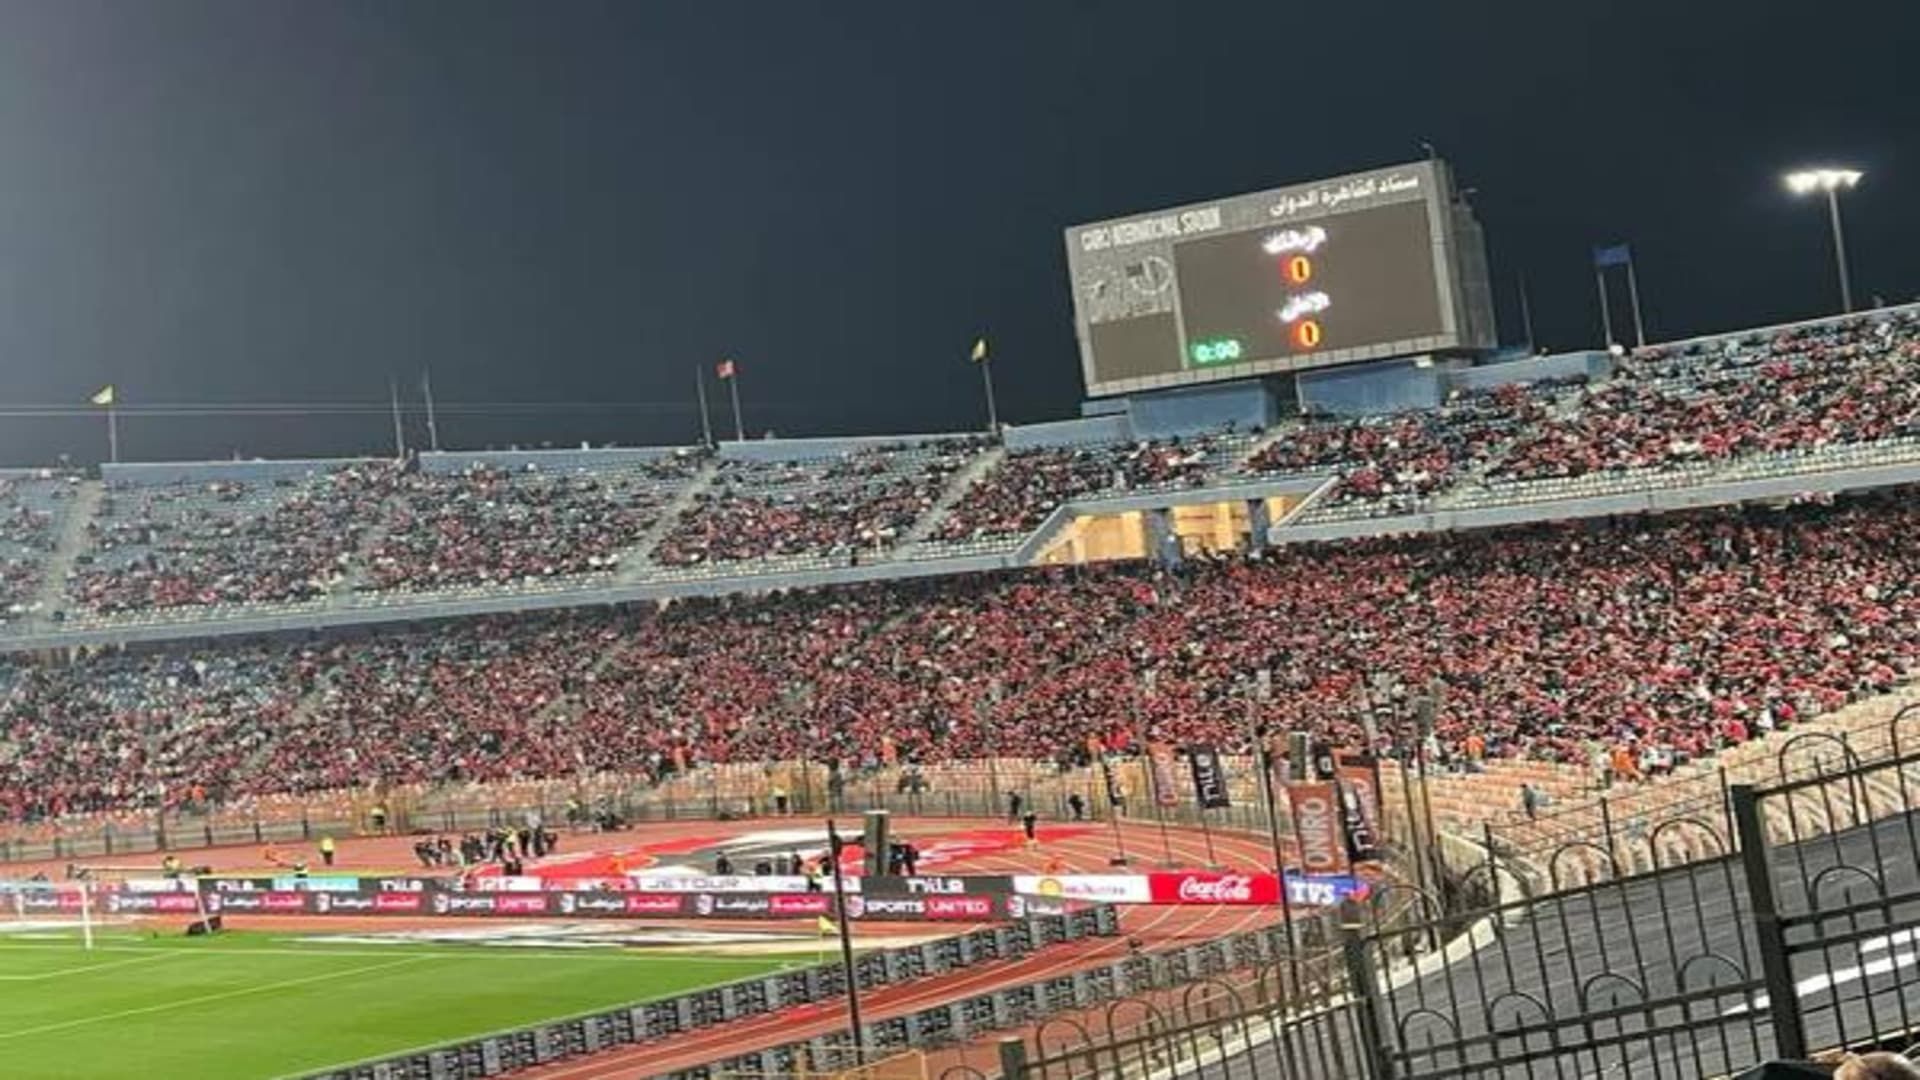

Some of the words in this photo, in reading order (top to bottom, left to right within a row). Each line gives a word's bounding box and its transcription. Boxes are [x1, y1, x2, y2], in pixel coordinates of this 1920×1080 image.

[1290, 255, 1311, 283] 0
[1299, 320, 1320, 347] 0
[1291, 882, 1335, 904] TVS
[866, 900, 926, 914] SPORTS
[928, 901, 990, 914] UNITED
